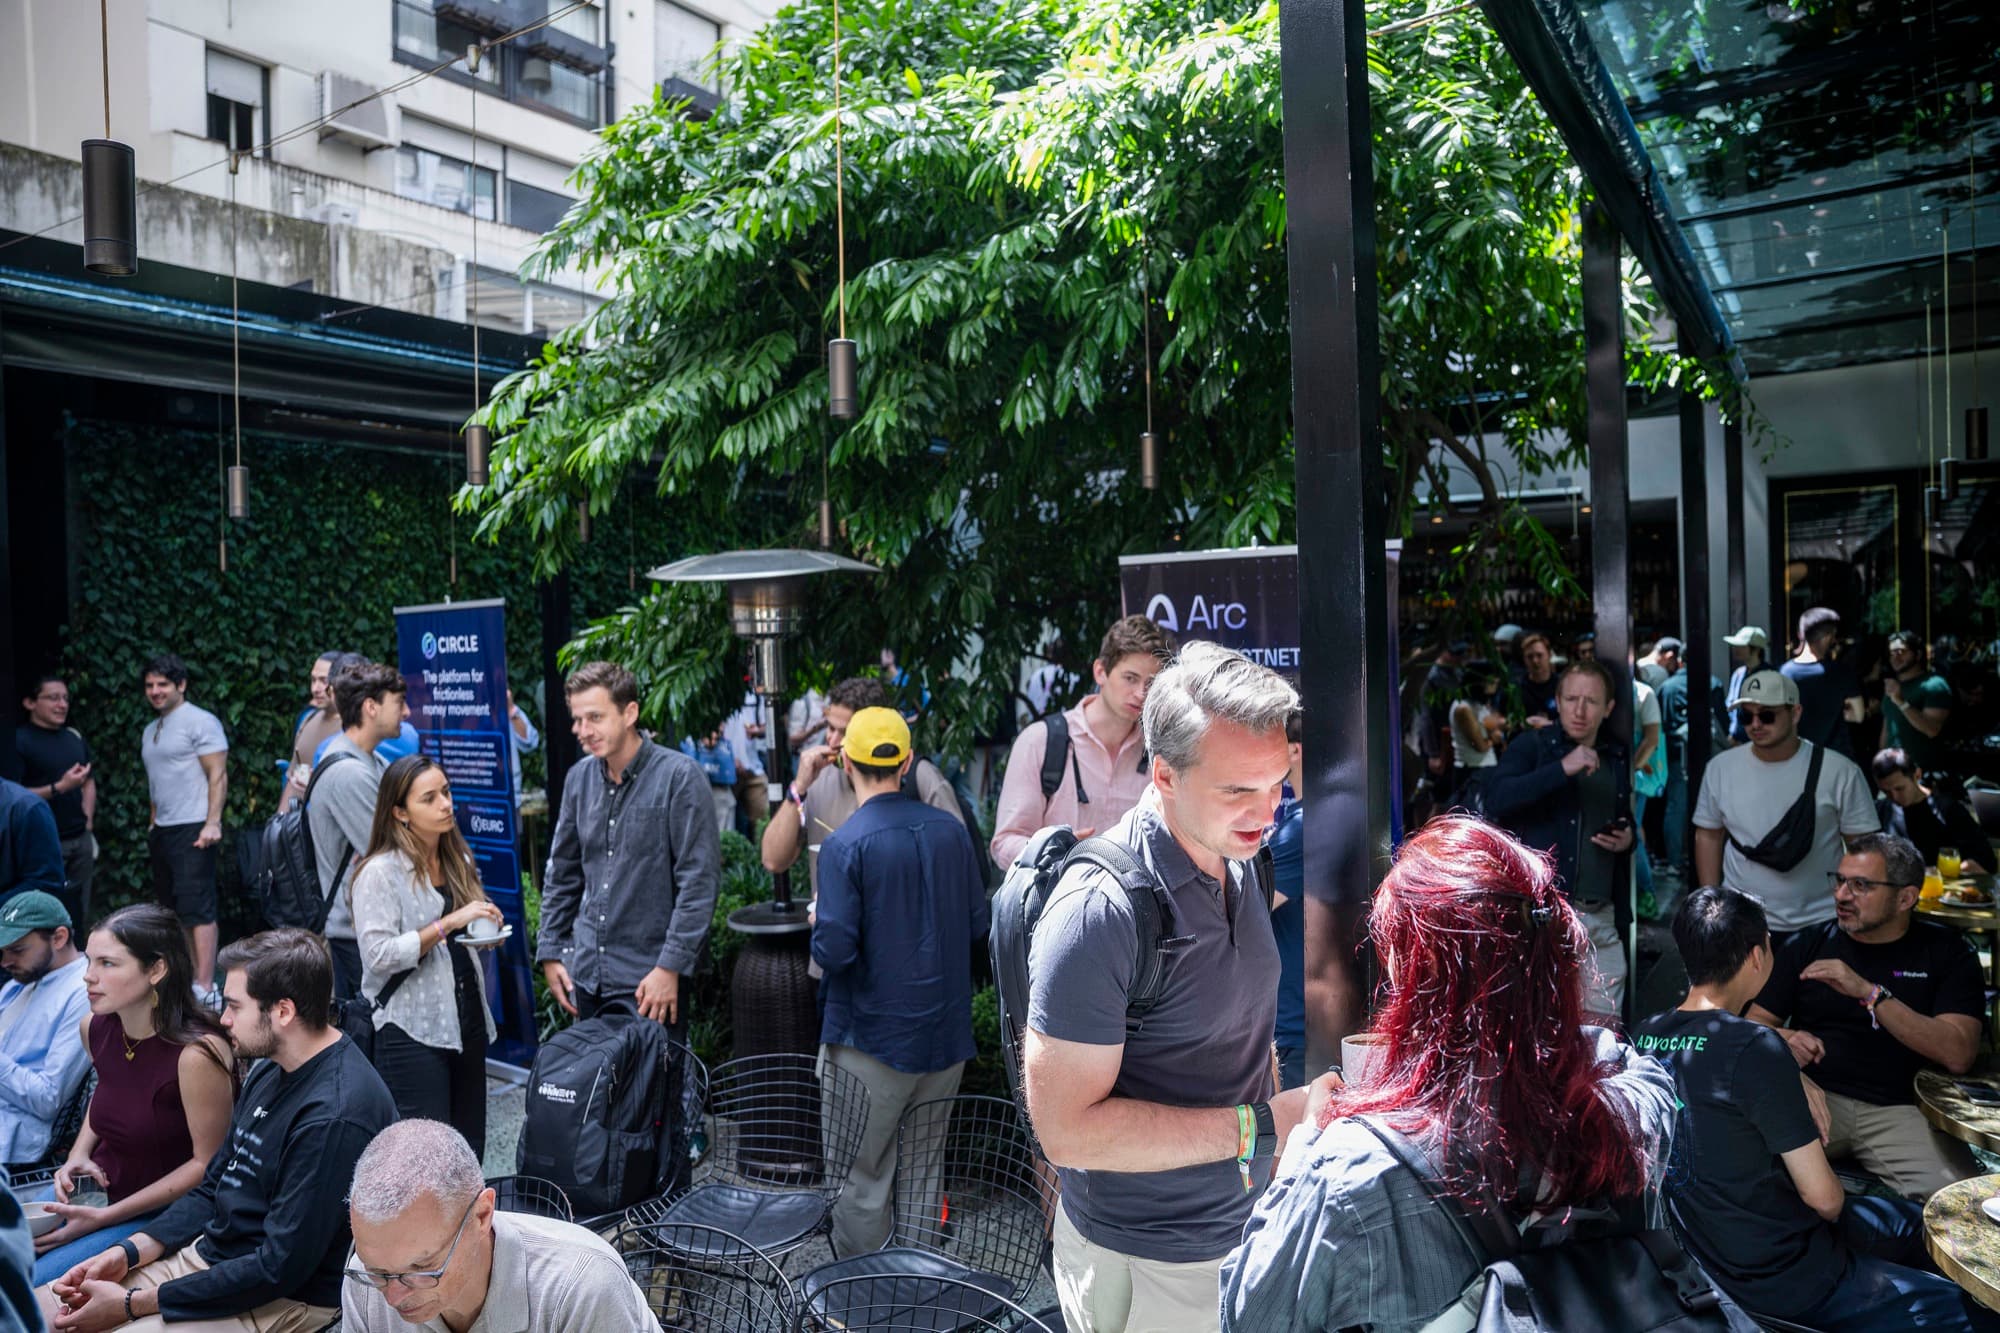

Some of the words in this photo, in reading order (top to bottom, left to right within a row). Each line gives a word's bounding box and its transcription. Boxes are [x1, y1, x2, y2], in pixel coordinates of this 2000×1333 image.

[1186, 594, 1247, 630] Arc
[437, 635, 479, 653] CIRCLE
[422, 669, 438, 684] The
[438, 668, 471, 685] platform
[471, 668, 484, 683] for
[432, 686, 475, 701] frictionless
[422, 704, 447, 718] money
[481, 818, 505, 833] EURC
[1636, 1034, 1708, 1051] ADVOCATE
